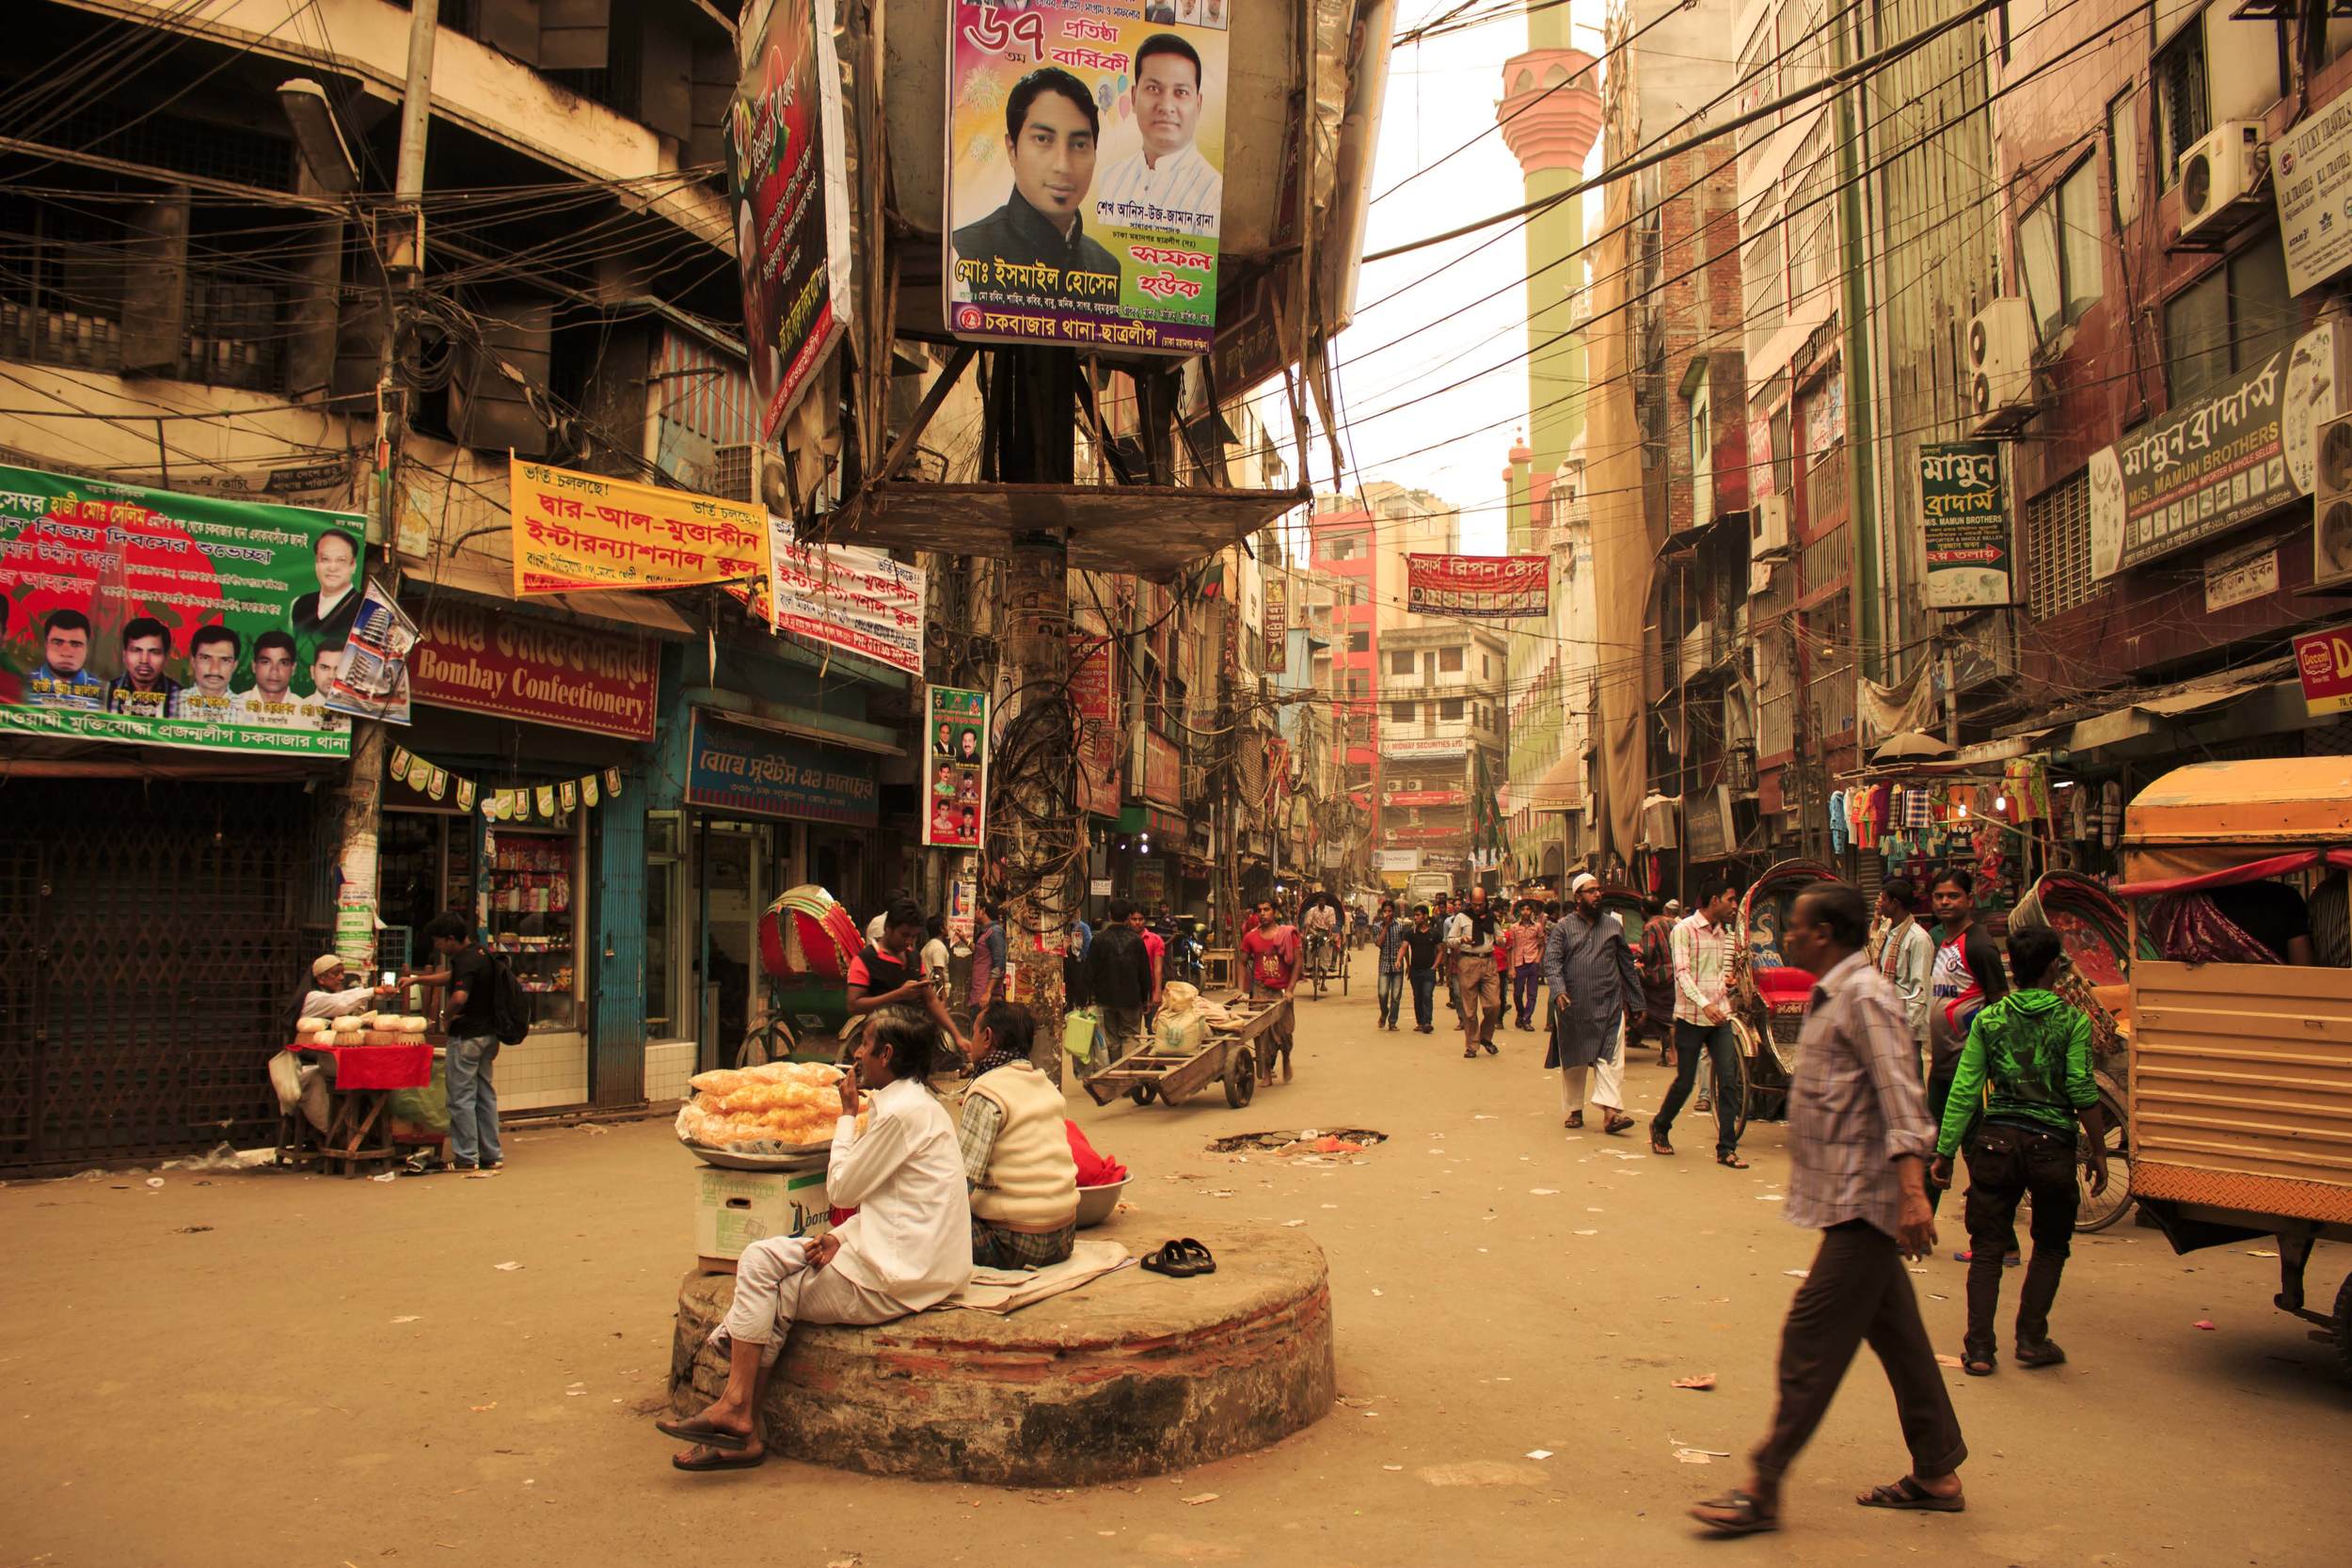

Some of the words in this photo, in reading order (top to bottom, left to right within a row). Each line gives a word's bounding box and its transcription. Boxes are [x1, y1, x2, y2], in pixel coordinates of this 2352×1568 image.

[963, 7, 1044, 63] ৬৭
[1062, 18, 1119, 43] প্রতিষ্ঠা
[1005, 51, 1026, 64] তম
[1051, 47, 1130, 74] বার্ষিকী
[1097, 200, 1115, 216] শেখ
[1196, 213, 1215, 229] রানা
[1129, 245, 1215, 272] সফল
[954, 256, 990, 285] মোঃ
[993, 255, 1060, 293] ইসমাইল
[1065, 267, 1120, 298] হোসেন
[1137, 270, 1203, 302] হউক
[983, 311, 1057, 338] চকবাজার
[1061, 317, 1097, 341] থানা
[1099, 320, 1158, 347] ছাত্রলীগ
[2122, 420, 2187, 475] মামুন
[2187, 352, 2281, 451] ব্রাদার্স
[523, 465, 552, 484] ভর্তি
[1920, 452, 1997, 489] মামুন
[2129, 485, 2152, 508] M/S.
[2154, 459, 2200, 496] MAMUN
[2202, 420, 2280, 472] BROTHERS
[50, 491, 79, 517] হাজী
[82, 500, 106, 521] মোঃ
[110, 501, 148, 525] সেলিম
[691, 500, 716, 518] ভর্তি
[1925, 483, 2001, 517] ব্রাদার্স
[536, 492, 761, 552] দ্বার-আল-মুত্তাকীন
[1939, 516, 1964, 525] MAMUN
[1966, 515, 2003, 525] BROTHERS
[32, 516, 103, 544] বিজয়
[104, 527, 192, 554] দিবসের
[195, 541, 276, 565] শুভেচ্ছা
[38, 539, 77, 566] উদ্দীন
[78, 549, 120, 573] কাবুল
[524, 515, 707, 573] ইন্টারন্যাশনাল
[713, 554, 760, 578] স্কুল
[878, 557, 894, 574] ভর্তি
[1450, 556, 1501, 578] রিপন
[417, 648, 507, 700] Bombay
[512, 668, 646, 725] Confectionery
[70, 713, 153, 737] মুক্তিযোদ্ধা
[157, 721, 236, 744] প্রজন্মলীগ
[240, 730, 311, 749] চকবাজার
[316, 737, 351, 752] থানা
[1392, 741, 1416, 751] MIDWAY
[1416, 739, 1451, 750] SECURITIES
[700, 750, 748, 777] বোম্বে
[825, 772, 874, 800] চানাচুর
